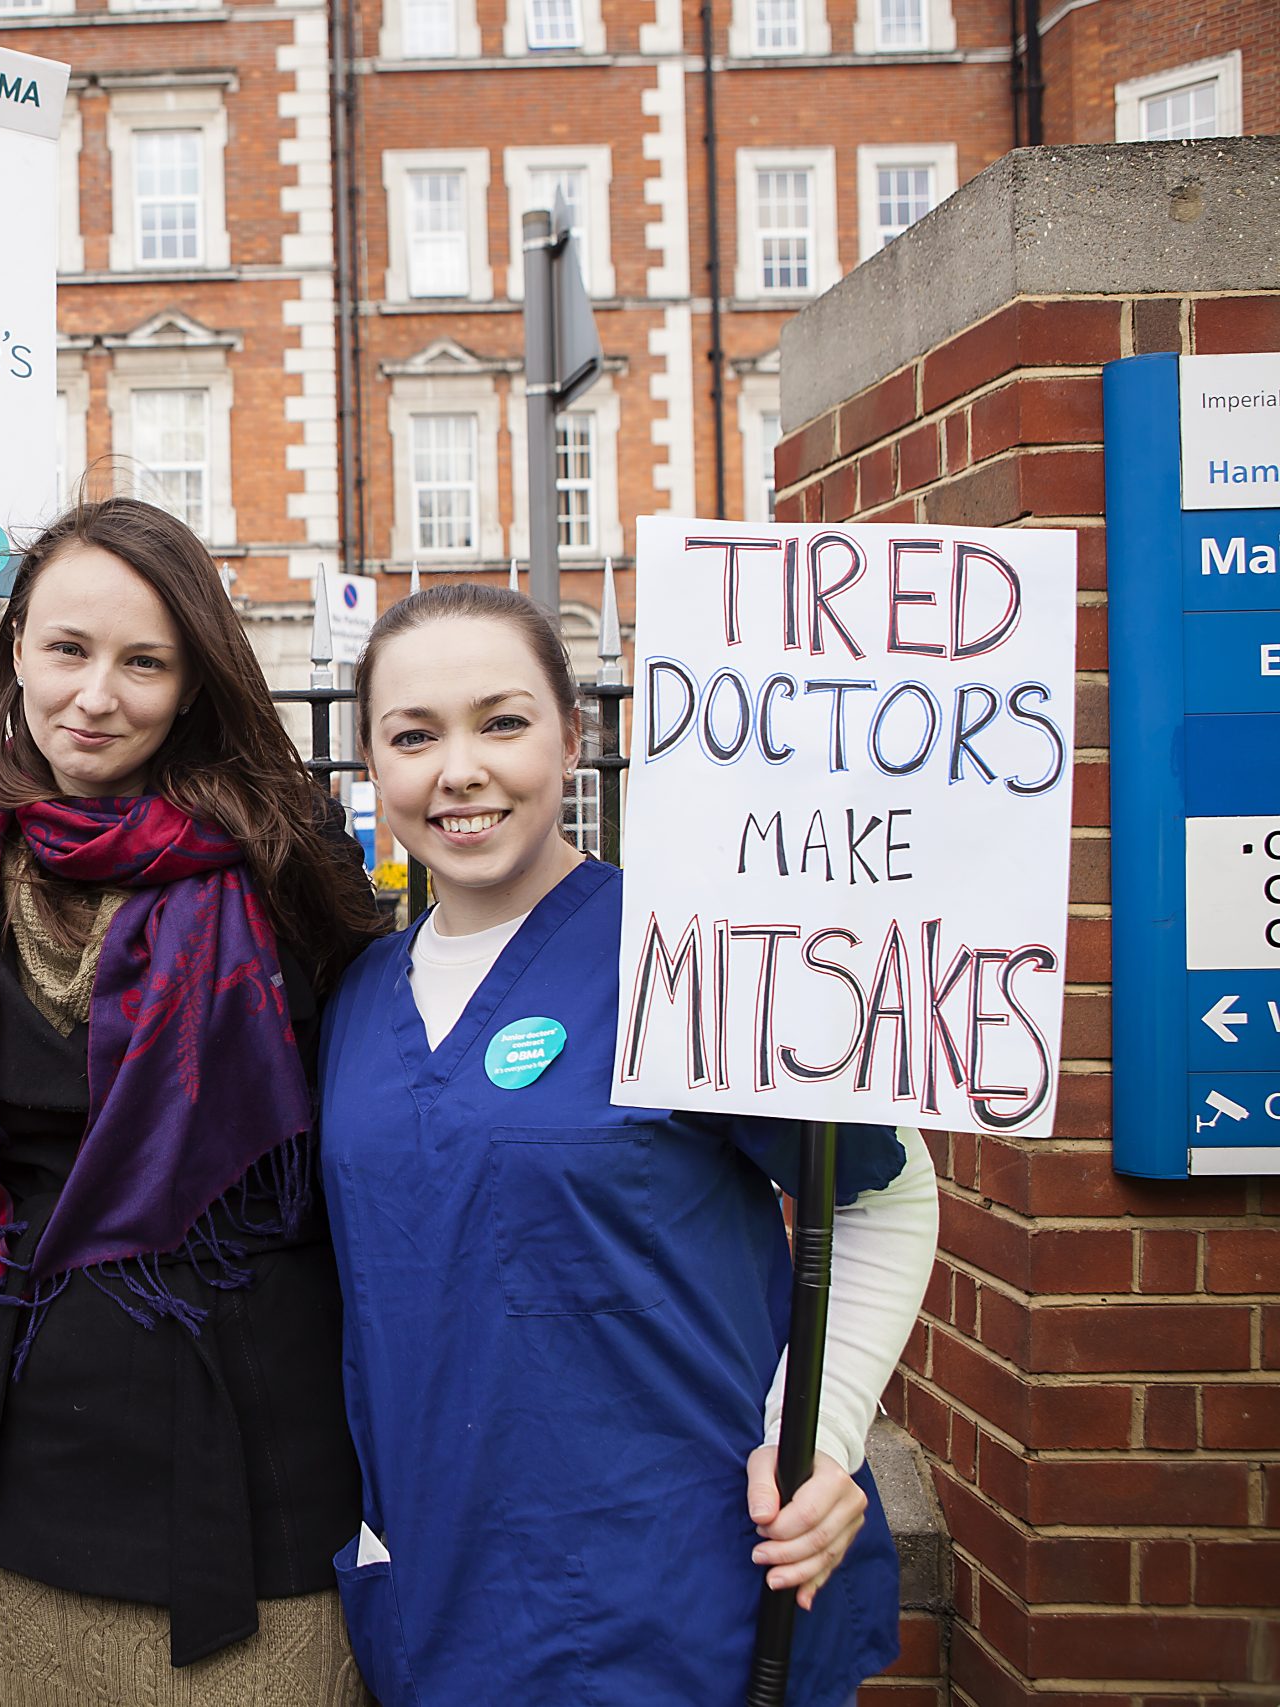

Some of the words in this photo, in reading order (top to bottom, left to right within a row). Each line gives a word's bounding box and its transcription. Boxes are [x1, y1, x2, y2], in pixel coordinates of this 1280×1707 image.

[685, 530, 1021, 661] TIRED
[644, 655, 1067, 797] DOCTORS
[737, 808, 913, 885] MAKE
[518, 1048, 545, 1061] BMA
[621, 911, 1058, 1133] MITSAKES
